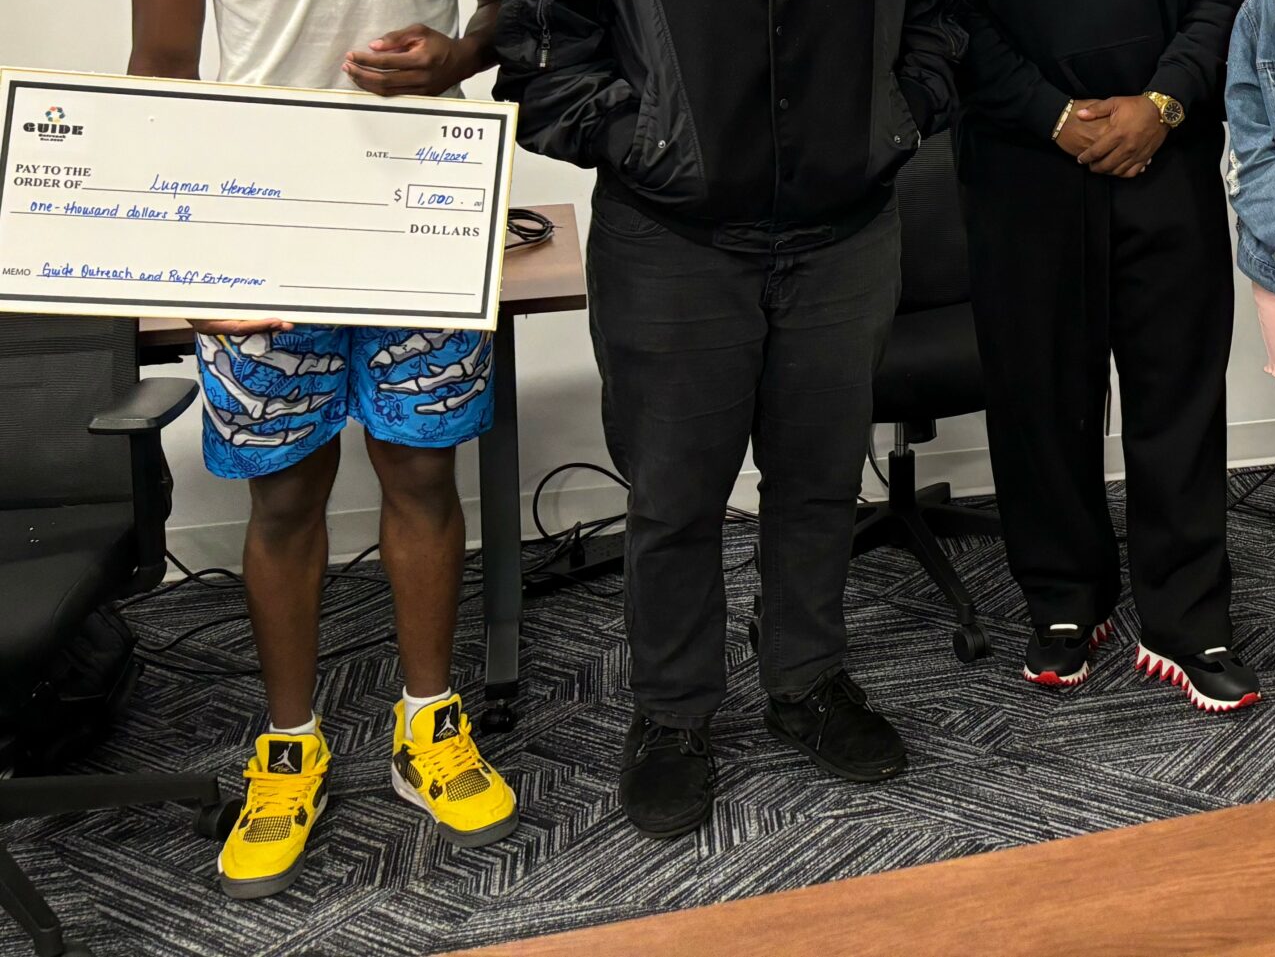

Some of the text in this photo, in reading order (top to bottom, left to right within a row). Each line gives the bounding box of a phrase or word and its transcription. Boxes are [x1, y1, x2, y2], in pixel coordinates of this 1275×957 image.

[23, 122, 84, 136] GUIDE
[440, 125, 485, 140] 1001
[366, 150, 389, 159] DATE
[415, 146, 469, 165] 4/16/2024
[15, 164, 91, 177] PAY TO THE
[14, 177, 82, 189] ORDER OF
[220, 179, 281, 198] Henderson
[394, 188, 402, 202] $
[127, 206, 168, 220] dollars
[410, 224, 480, 237] DOLLARS
[2, 268, 31, 276] MEMO
[42, 262, 74, 277] Guide
[81, 263, 133, 280] Outreach
[139, 271, 163, 282] and
